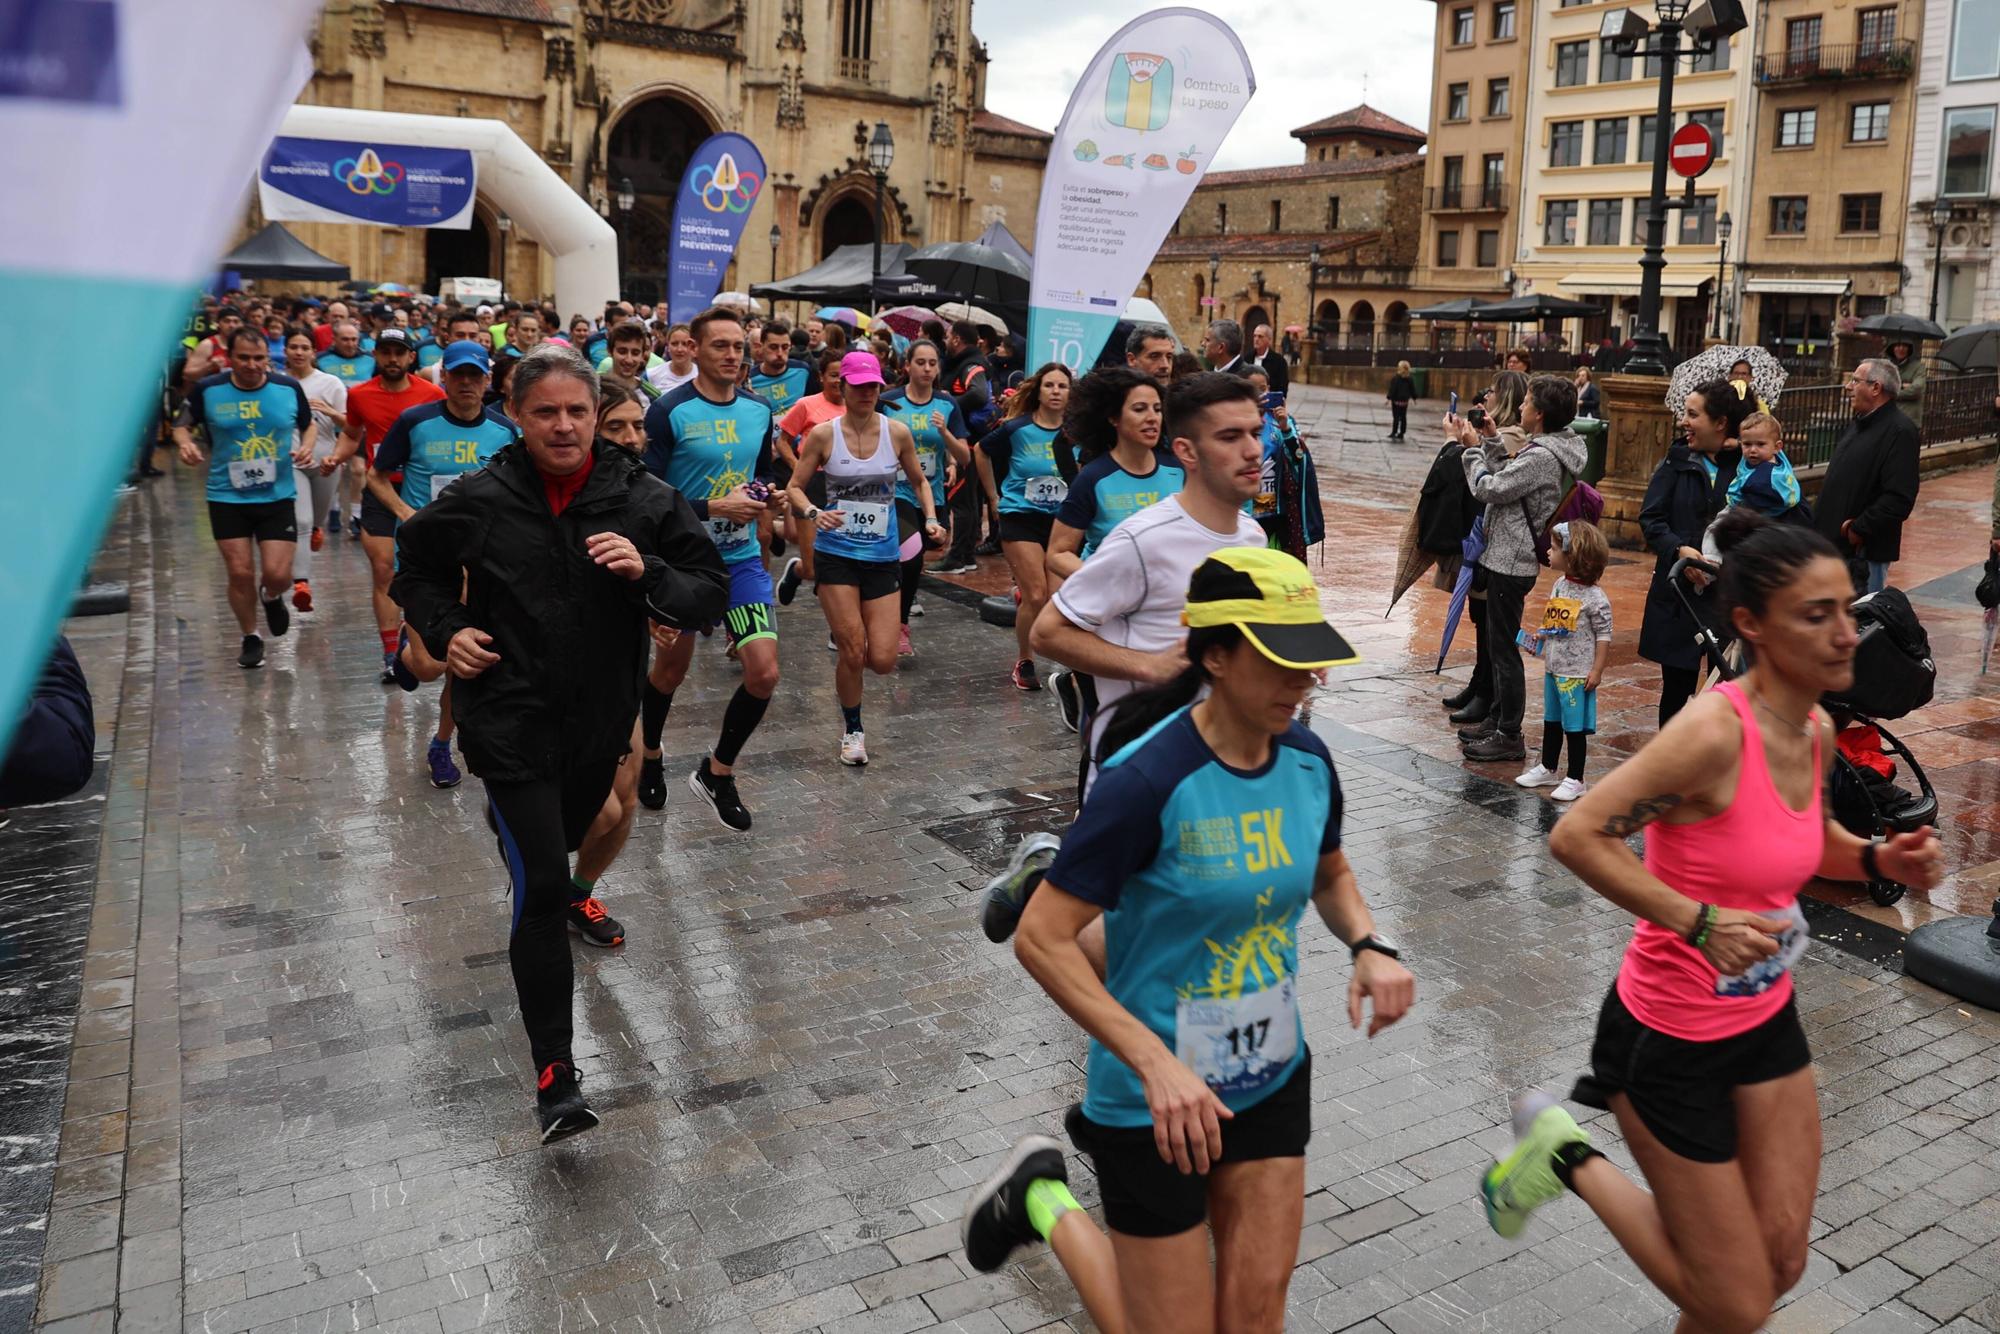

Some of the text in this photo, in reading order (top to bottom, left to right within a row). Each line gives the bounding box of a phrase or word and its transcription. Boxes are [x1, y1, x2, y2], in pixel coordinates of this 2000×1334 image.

[1184, 77, 1241, 94] Controla
[1182, 96, 1230, 111] tu peso
[1063, 184, 1079, 193] Evita
[1088, 187, 1124, 197] sobrepeso
[1061, 203, 1139, 218] Sigue una alimentación
[680, 224, 730, 238] DEPORTIVOS
[1059, 224, 1096, 234] equilibrada
[679, 240, 734, 254] PREVENTIVOS
[1057, 232, 1085, 243] Asegura
[1100, 237, 1124, 247] ingesta
[1057, 242, 1118, 256] adecuada de agua
[1048, 338, 1083, 369] 10
[771, 383, 788, 400] 5K
[239, 401, 262, 419] 5K
[912, 413, 929, 430] 5K
[714, 419, 740, 444] 5K
[454, 440, 478, 464] 5K
[1039, 484, 1059, 495] 291
[852, 512, 876, 526] 169
[1546, 607, 1570, 620] 1010
[1240, 807, 1295, 874] 5K
[1225, 1017, 1271, 1055] 117
